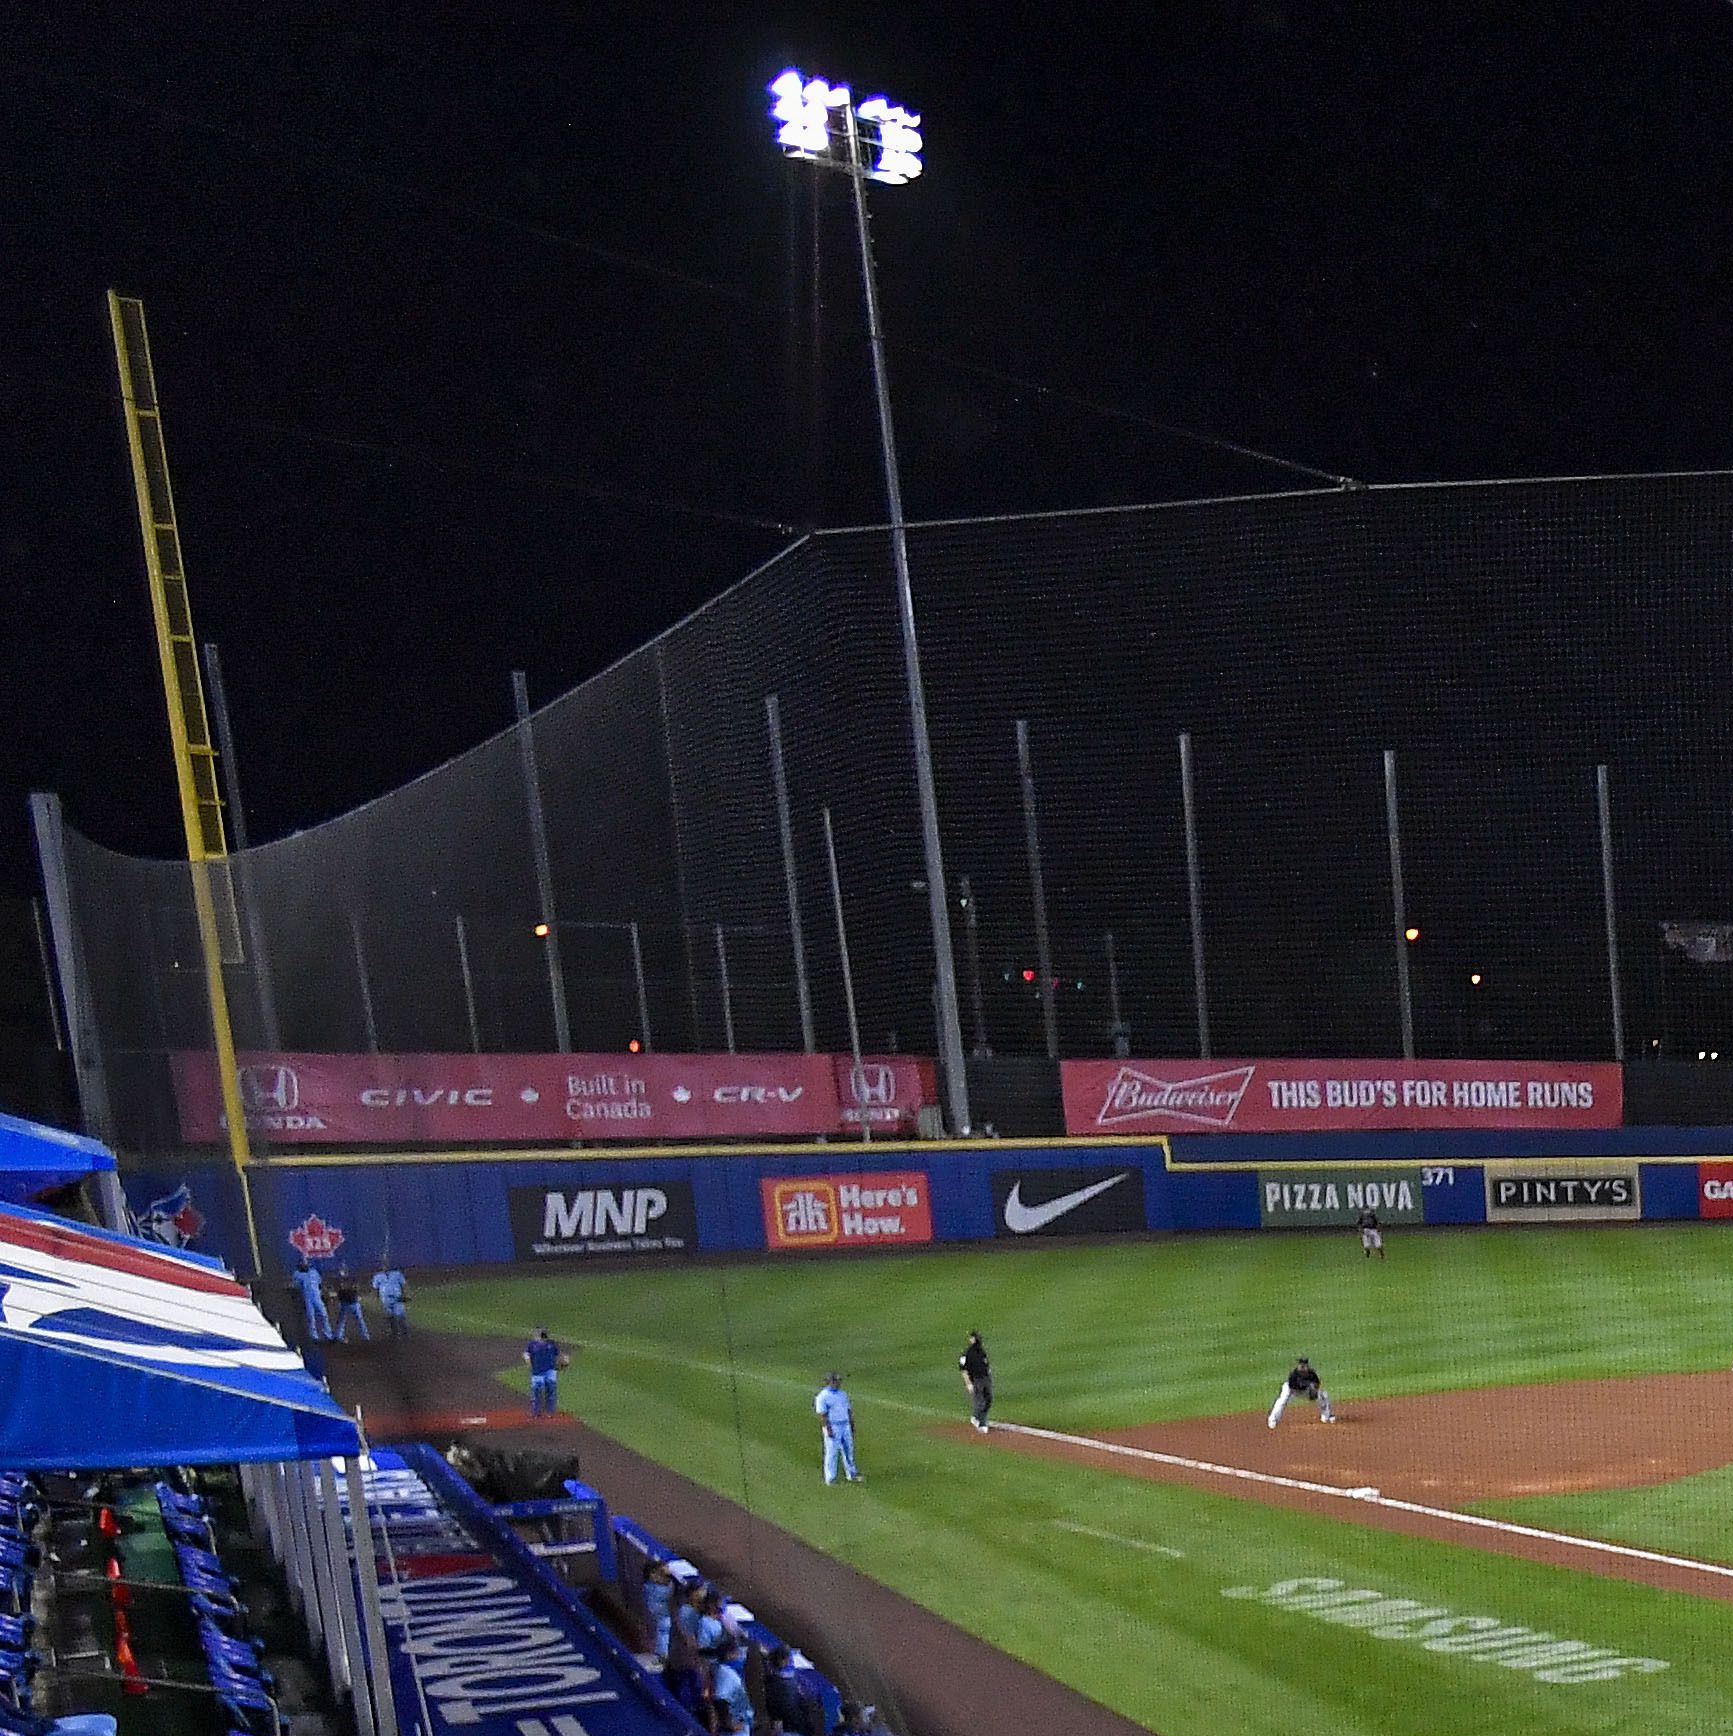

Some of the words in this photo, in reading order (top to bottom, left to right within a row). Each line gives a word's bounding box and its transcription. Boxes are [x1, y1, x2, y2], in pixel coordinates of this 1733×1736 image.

[361, 1088, 493, 1106] CIVIC
[568, 1075, 614, 1097] Built
[626, 1074, 646, 1095] in
[713, 1086, 803, 1102] CR-V
[1107, 1079, 1240, 1109] Budweiser
[1268, 1080, 1321, 1109] THIS
[1326, 1080, 1396, 1108] BUD'S
[1403, 1080, 1448, 1108] FOR
[1453, 1080, 1521, 1109] HOME
[1527, 1081, 1593, 1109] RUNS
[566, 1101, 651, 1120] Canada
[1422, 1168, 1454, 1186] 371
[840, 1184, 918, 1208] Here's
[1265, 1181, 1340, 1212] PIZZA
[1347, 1180, 1414, 1210] NOVA
[1500, 1180, 1628, 1204] PINTY'S
[544, 1187, 668, 1238] MNP
[843, 1212, 906, 1235] How.
